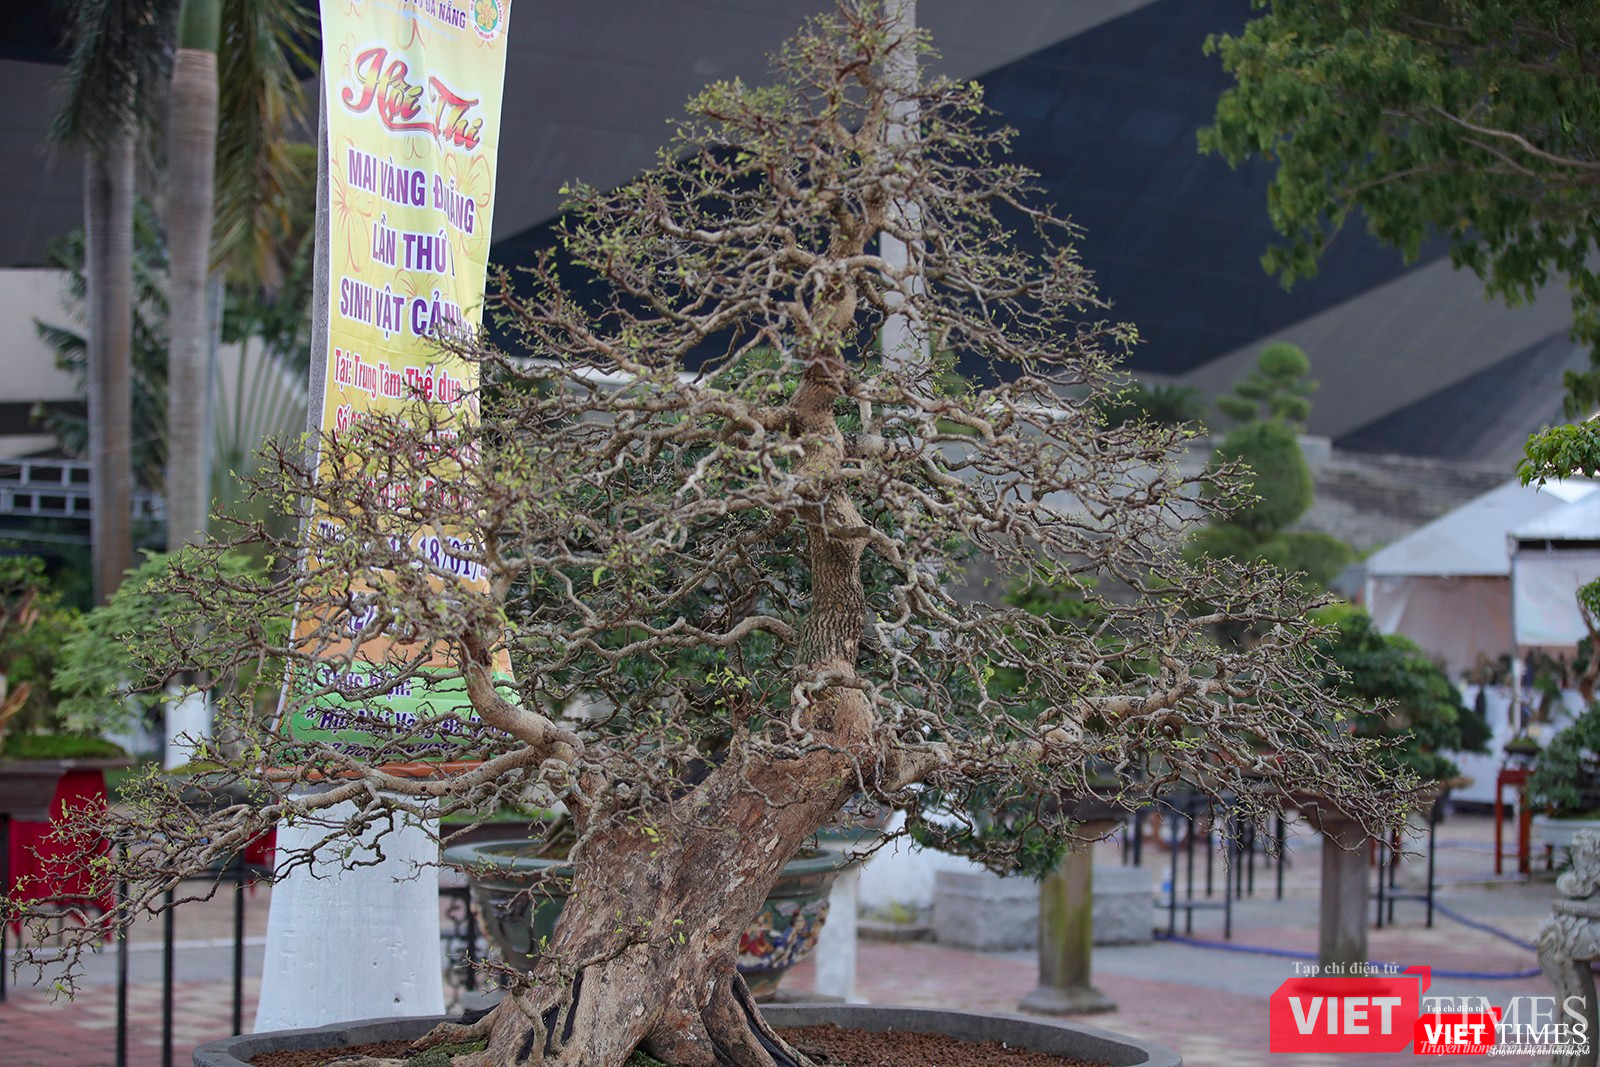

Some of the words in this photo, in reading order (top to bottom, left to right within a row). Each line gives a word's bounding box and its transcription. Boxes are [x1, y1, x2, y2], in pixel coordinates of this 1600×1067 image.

[348, 149, 377, 193] MAI
[380, 156, 426, 207] VÀNG
[372, 214, 396, 266] LẦN
[403, 229, 448, 273] THỨ
[340, 278, 372, 323] SINH
[376, 285, 405, 338] VẬT
[335, 349, 352, 390] Tại:
[355, 356, 377, 398] Trung
[379, 363, 401, 397] Tâm
[405, 364, 433, 400] Thể
